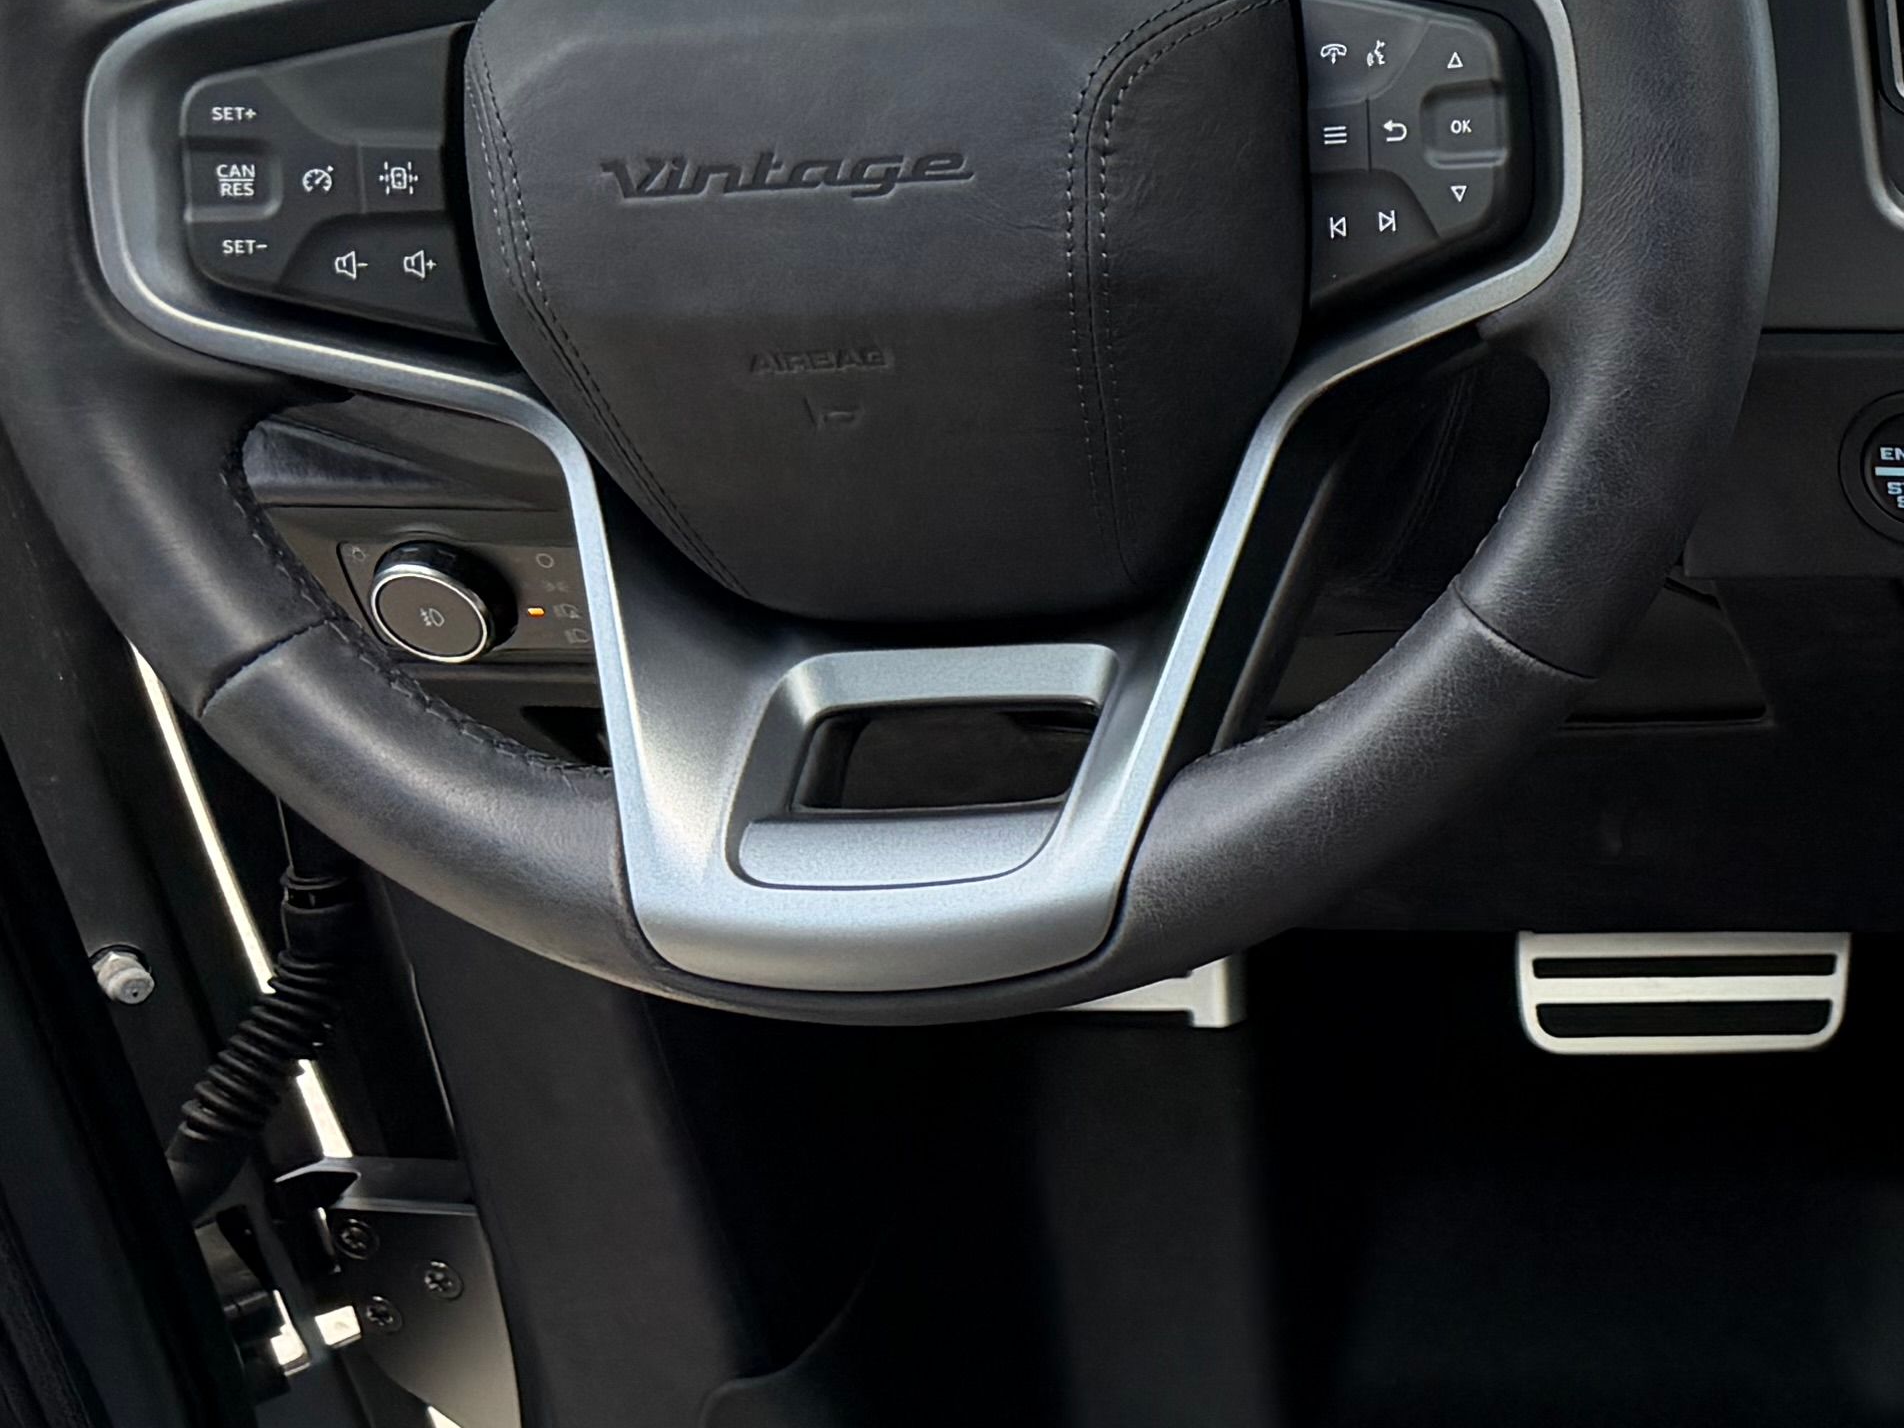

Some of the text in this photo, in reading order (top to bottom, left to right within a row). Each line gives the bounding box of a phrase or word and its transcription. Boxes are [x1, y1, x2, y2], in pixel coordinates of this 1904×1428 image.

[1450, 119, 1472, 135] OK
[216, 164, 256, 179] CAN
[600, 150, 975, 201] Vintage
[219, 182, 255, 197] RES
